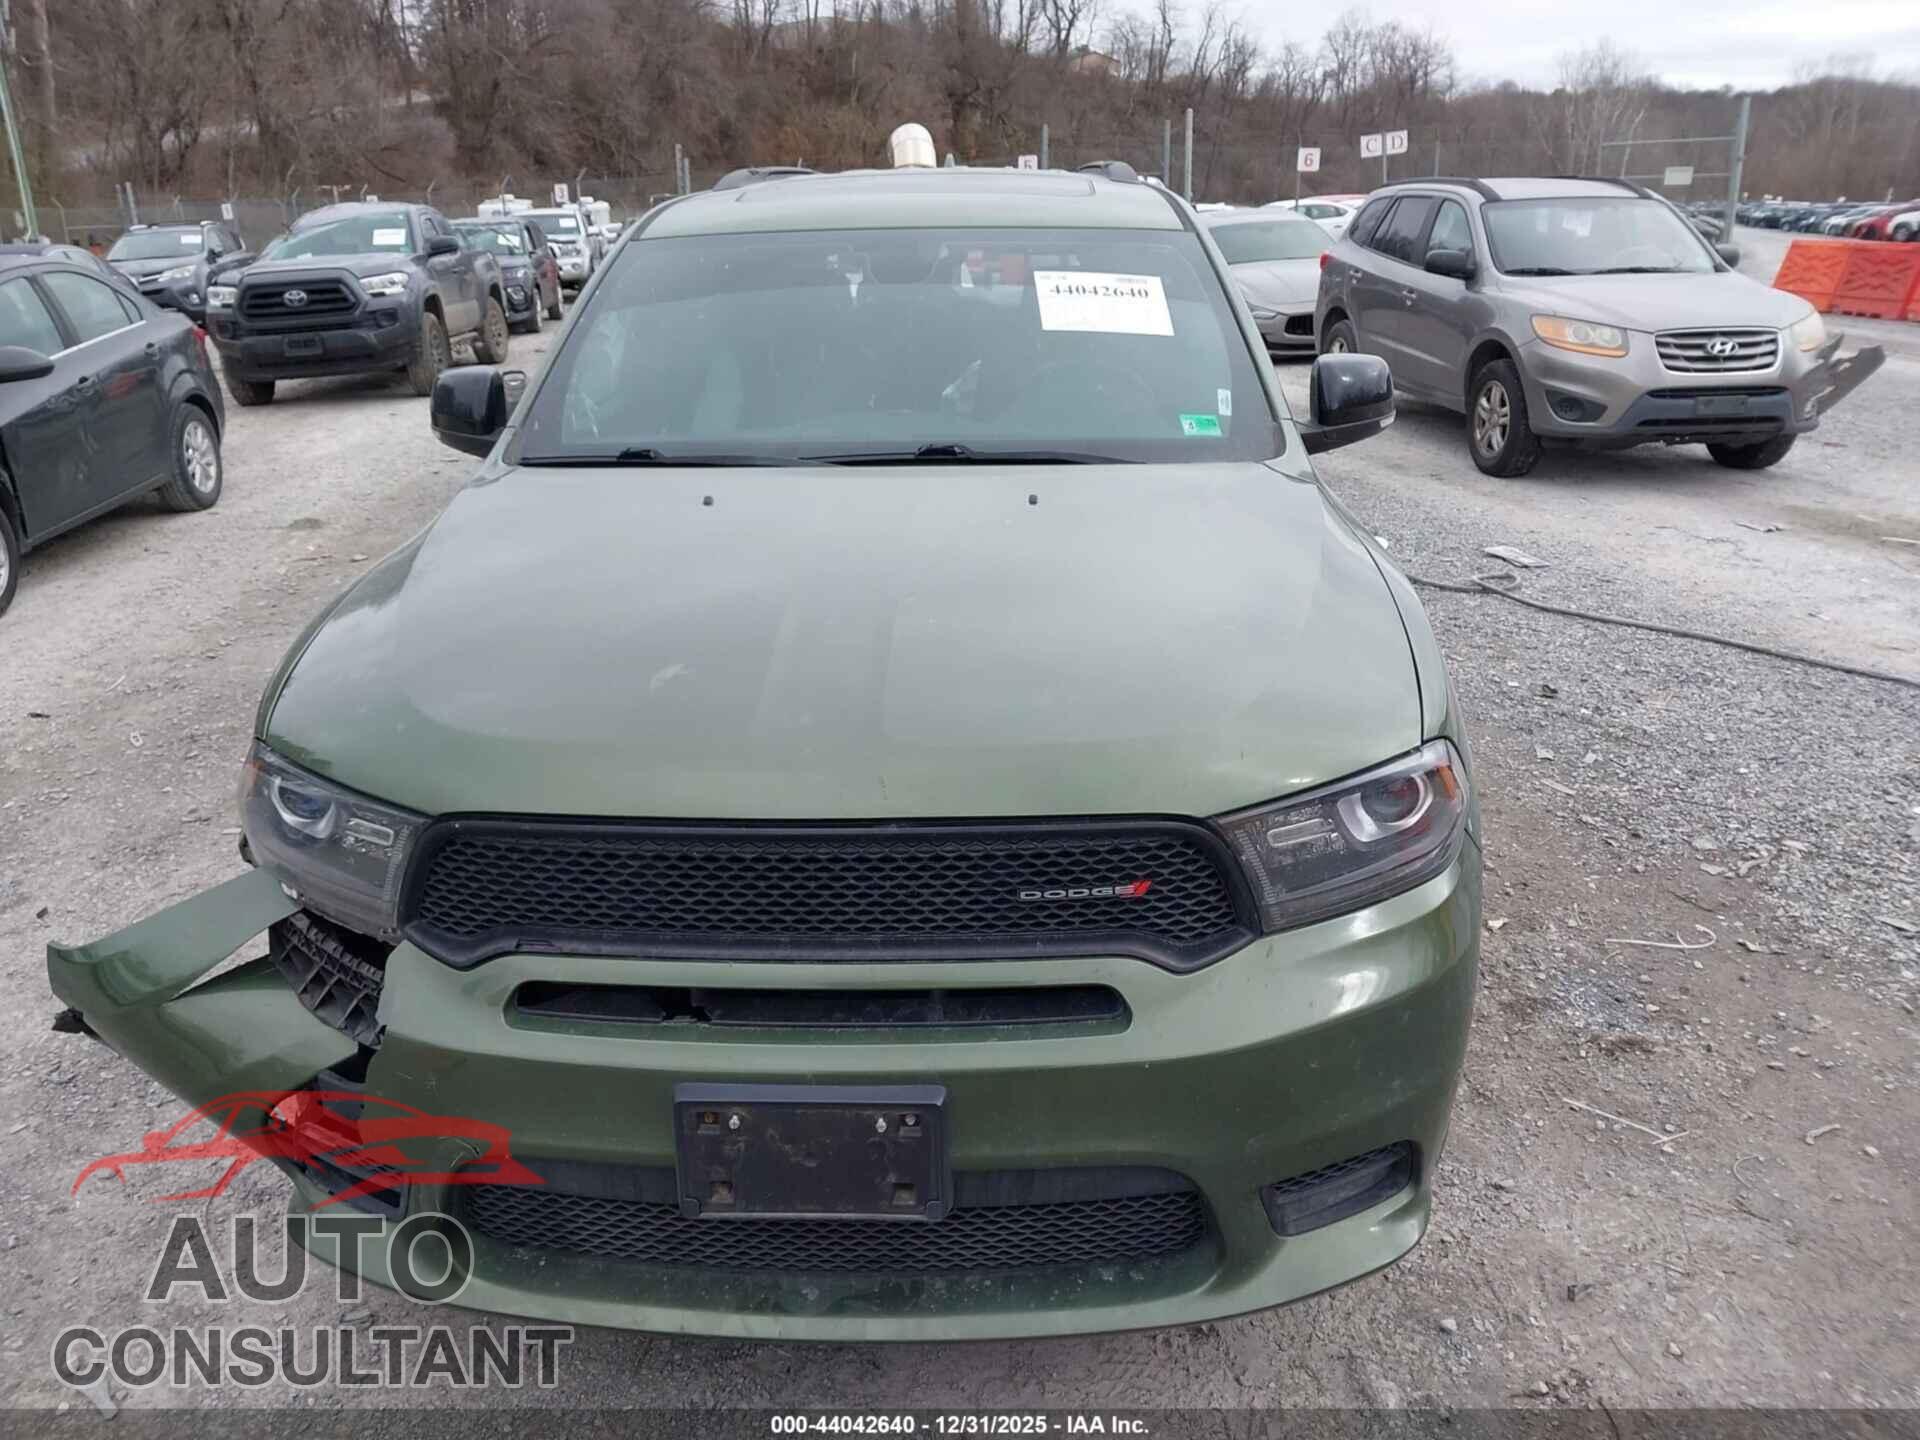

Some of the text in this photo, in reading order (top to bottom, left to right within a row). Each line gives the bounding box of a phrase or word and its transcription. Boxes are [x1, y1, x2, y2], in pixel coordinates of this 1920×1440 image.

[1366, 139, 1377, 153] C
[1391, 135, 1403, 149] D
[1304, 153, 1313, 167] 6
[1049, 284, 1149, 298] 44042640
[1020, 885, 1137, 899] DODGE
